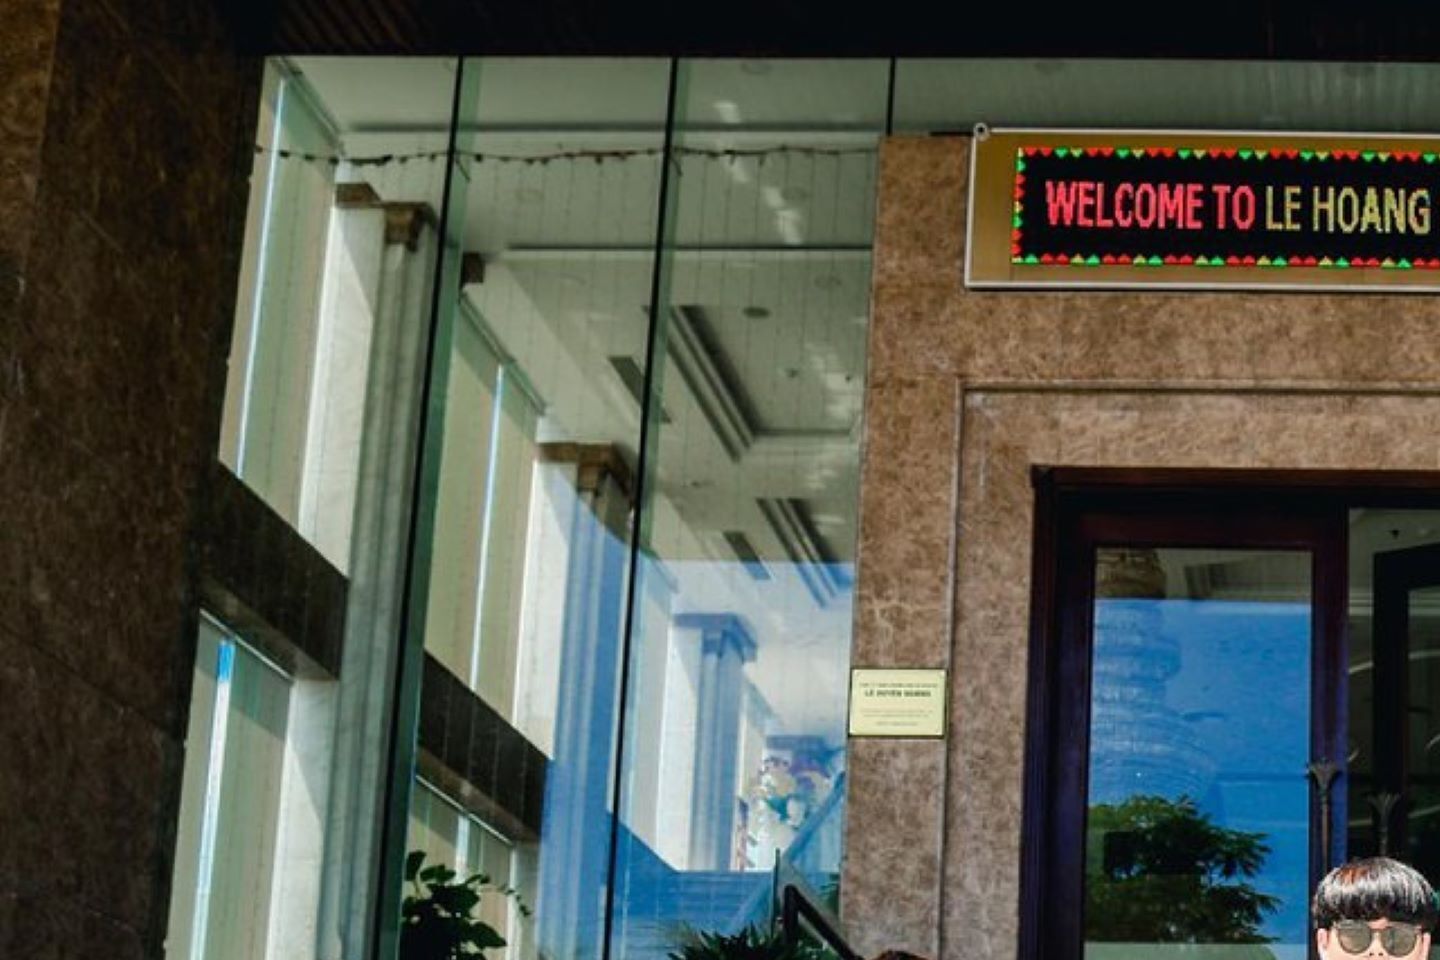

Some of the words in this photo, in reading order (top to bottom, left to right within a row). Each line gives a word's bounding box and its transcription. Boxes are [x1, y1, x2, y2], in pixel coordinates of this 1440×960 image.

[1045, 181, 1203, 228] WELCOME
[1212, 185, 1256, 229] TO
[1265, 186, 1301, 230] LE
[1312, 186, 1430, 233] HOANG
